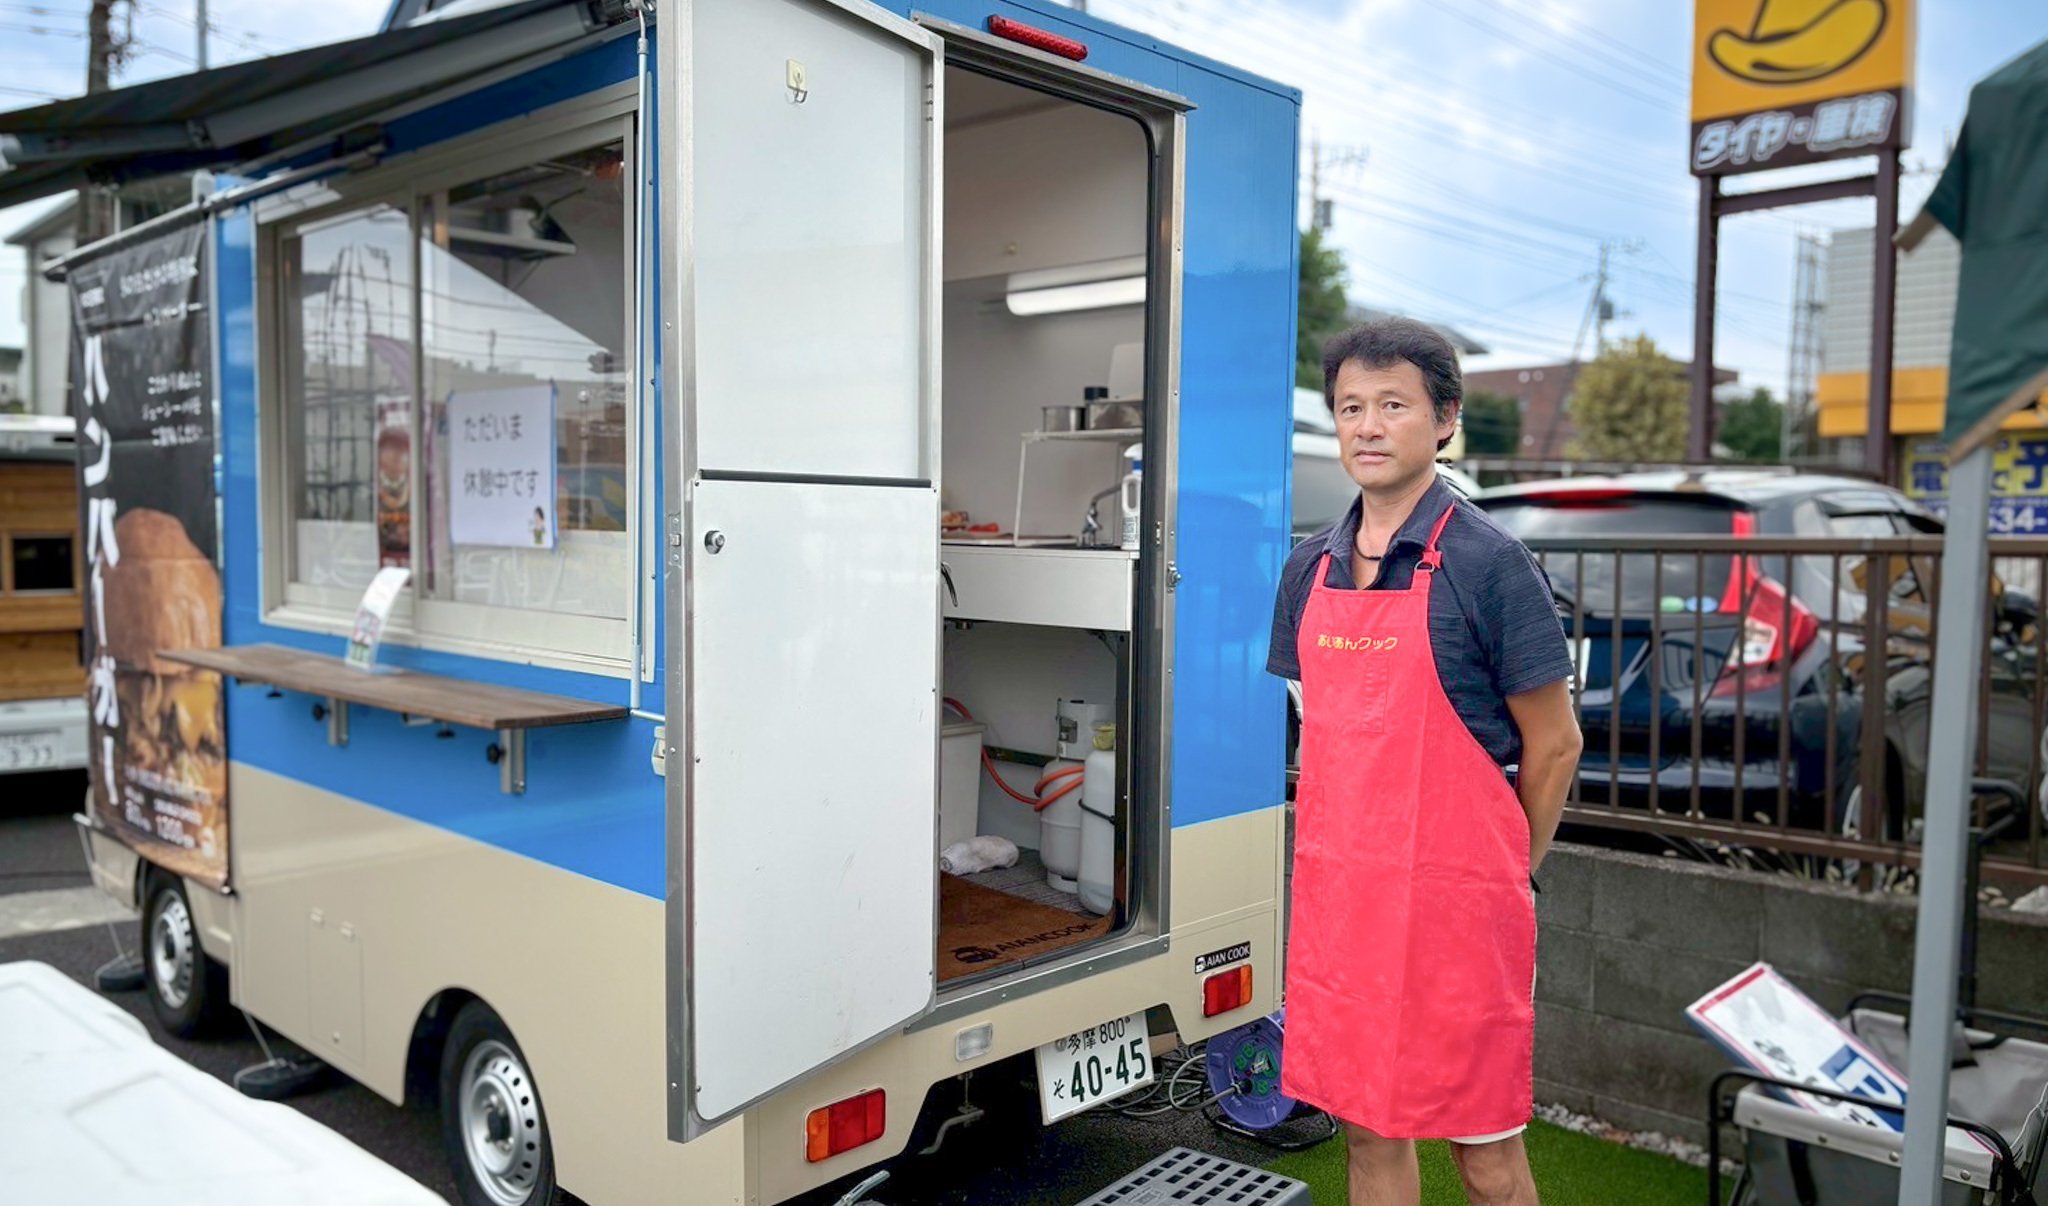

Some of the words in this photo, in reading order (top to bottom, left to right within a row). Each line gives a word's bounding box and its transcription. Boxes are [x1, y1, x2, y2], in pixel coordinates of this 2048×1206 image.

[463, 413, 522, 443] ただいま
[463, 469, 540, 499] 休憩中です
[1318, 633, 1398, 651] あいあんクック
[1206, 950, 1227, 967] AIAN
[1227, 944, 1251, 961] COOK
[1067, 1028, 1097, 1055] 多摩
[1099, 1018, 1125, 1044] 800
[1053, 1078, 1065, 1099] そ
[1071, 1037, 1146, 1103] 40-45
